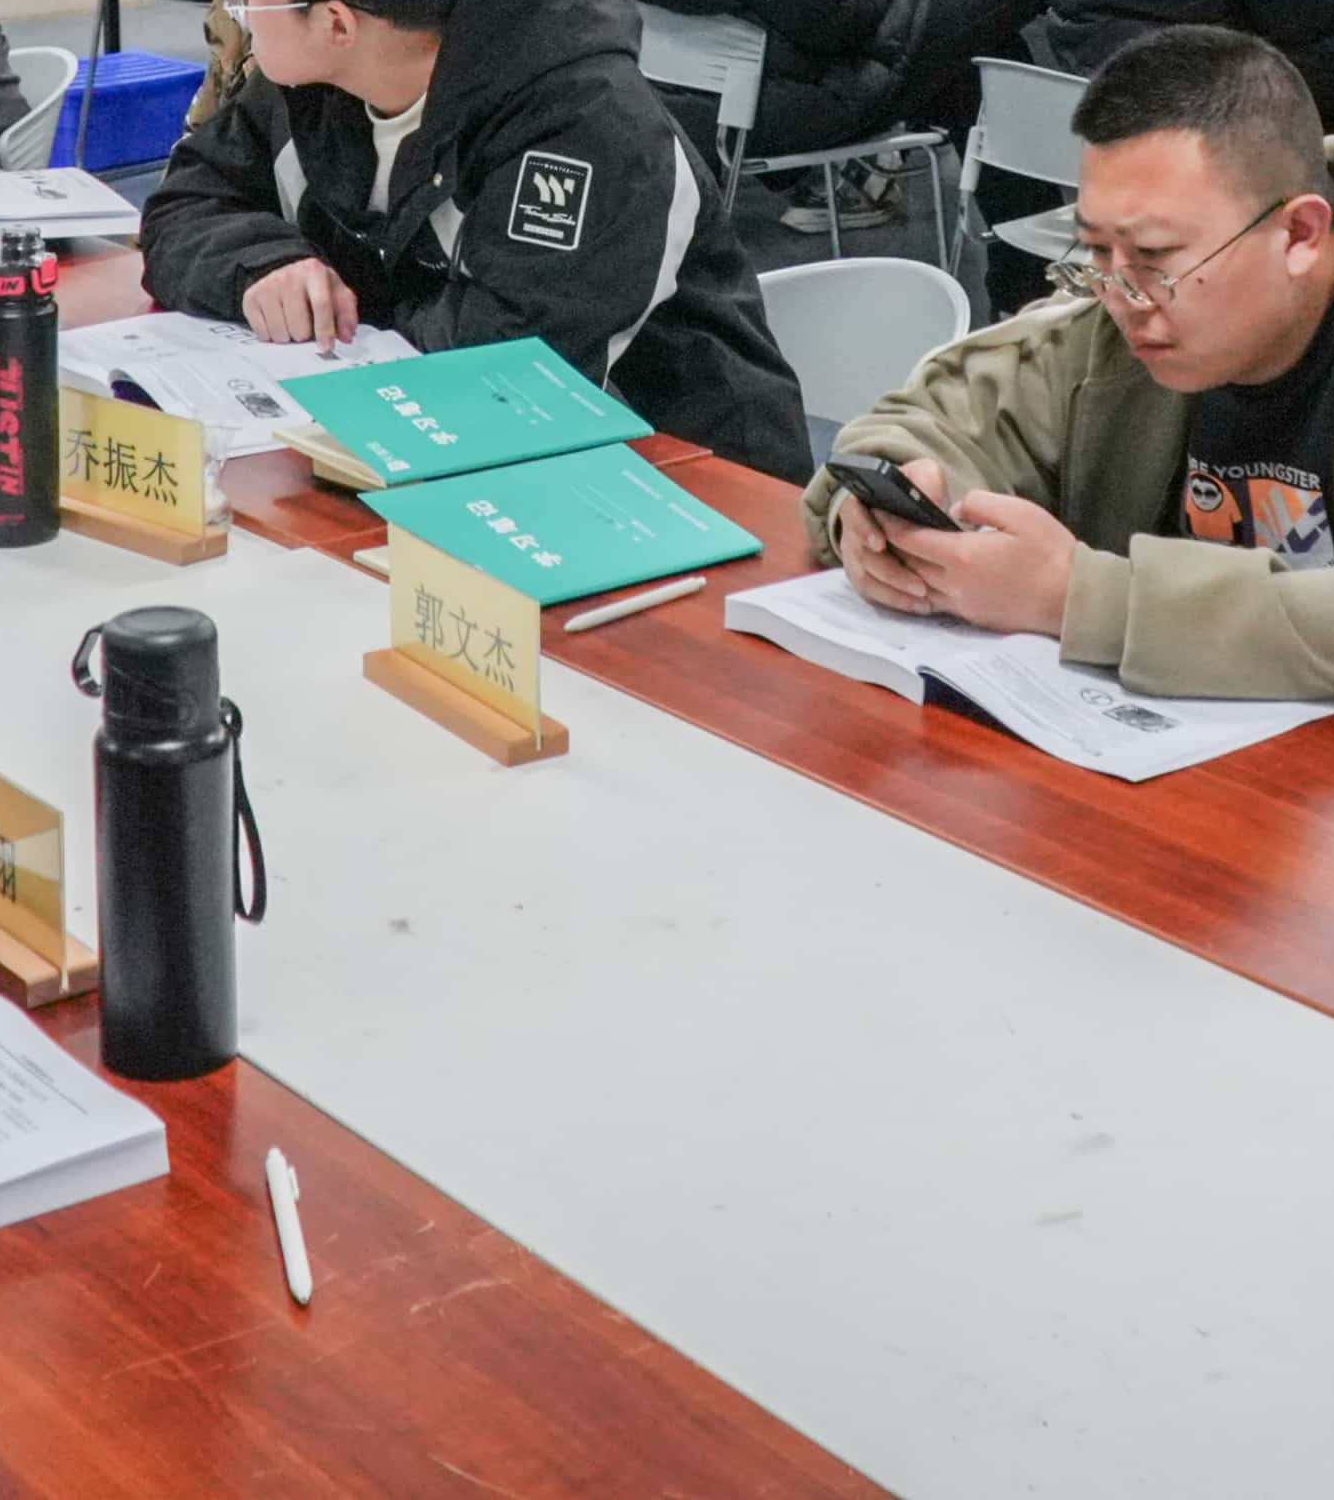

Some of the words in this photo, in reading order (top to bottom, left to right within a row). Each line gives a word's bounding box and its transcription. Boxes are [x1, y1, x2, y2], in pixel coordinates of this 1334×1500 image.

[64, 428, 180, 507] 乔振杰
[1213, 461, 1322, 490] YOUNGSTER
[414, 582, 515, 692] 郭文杰
